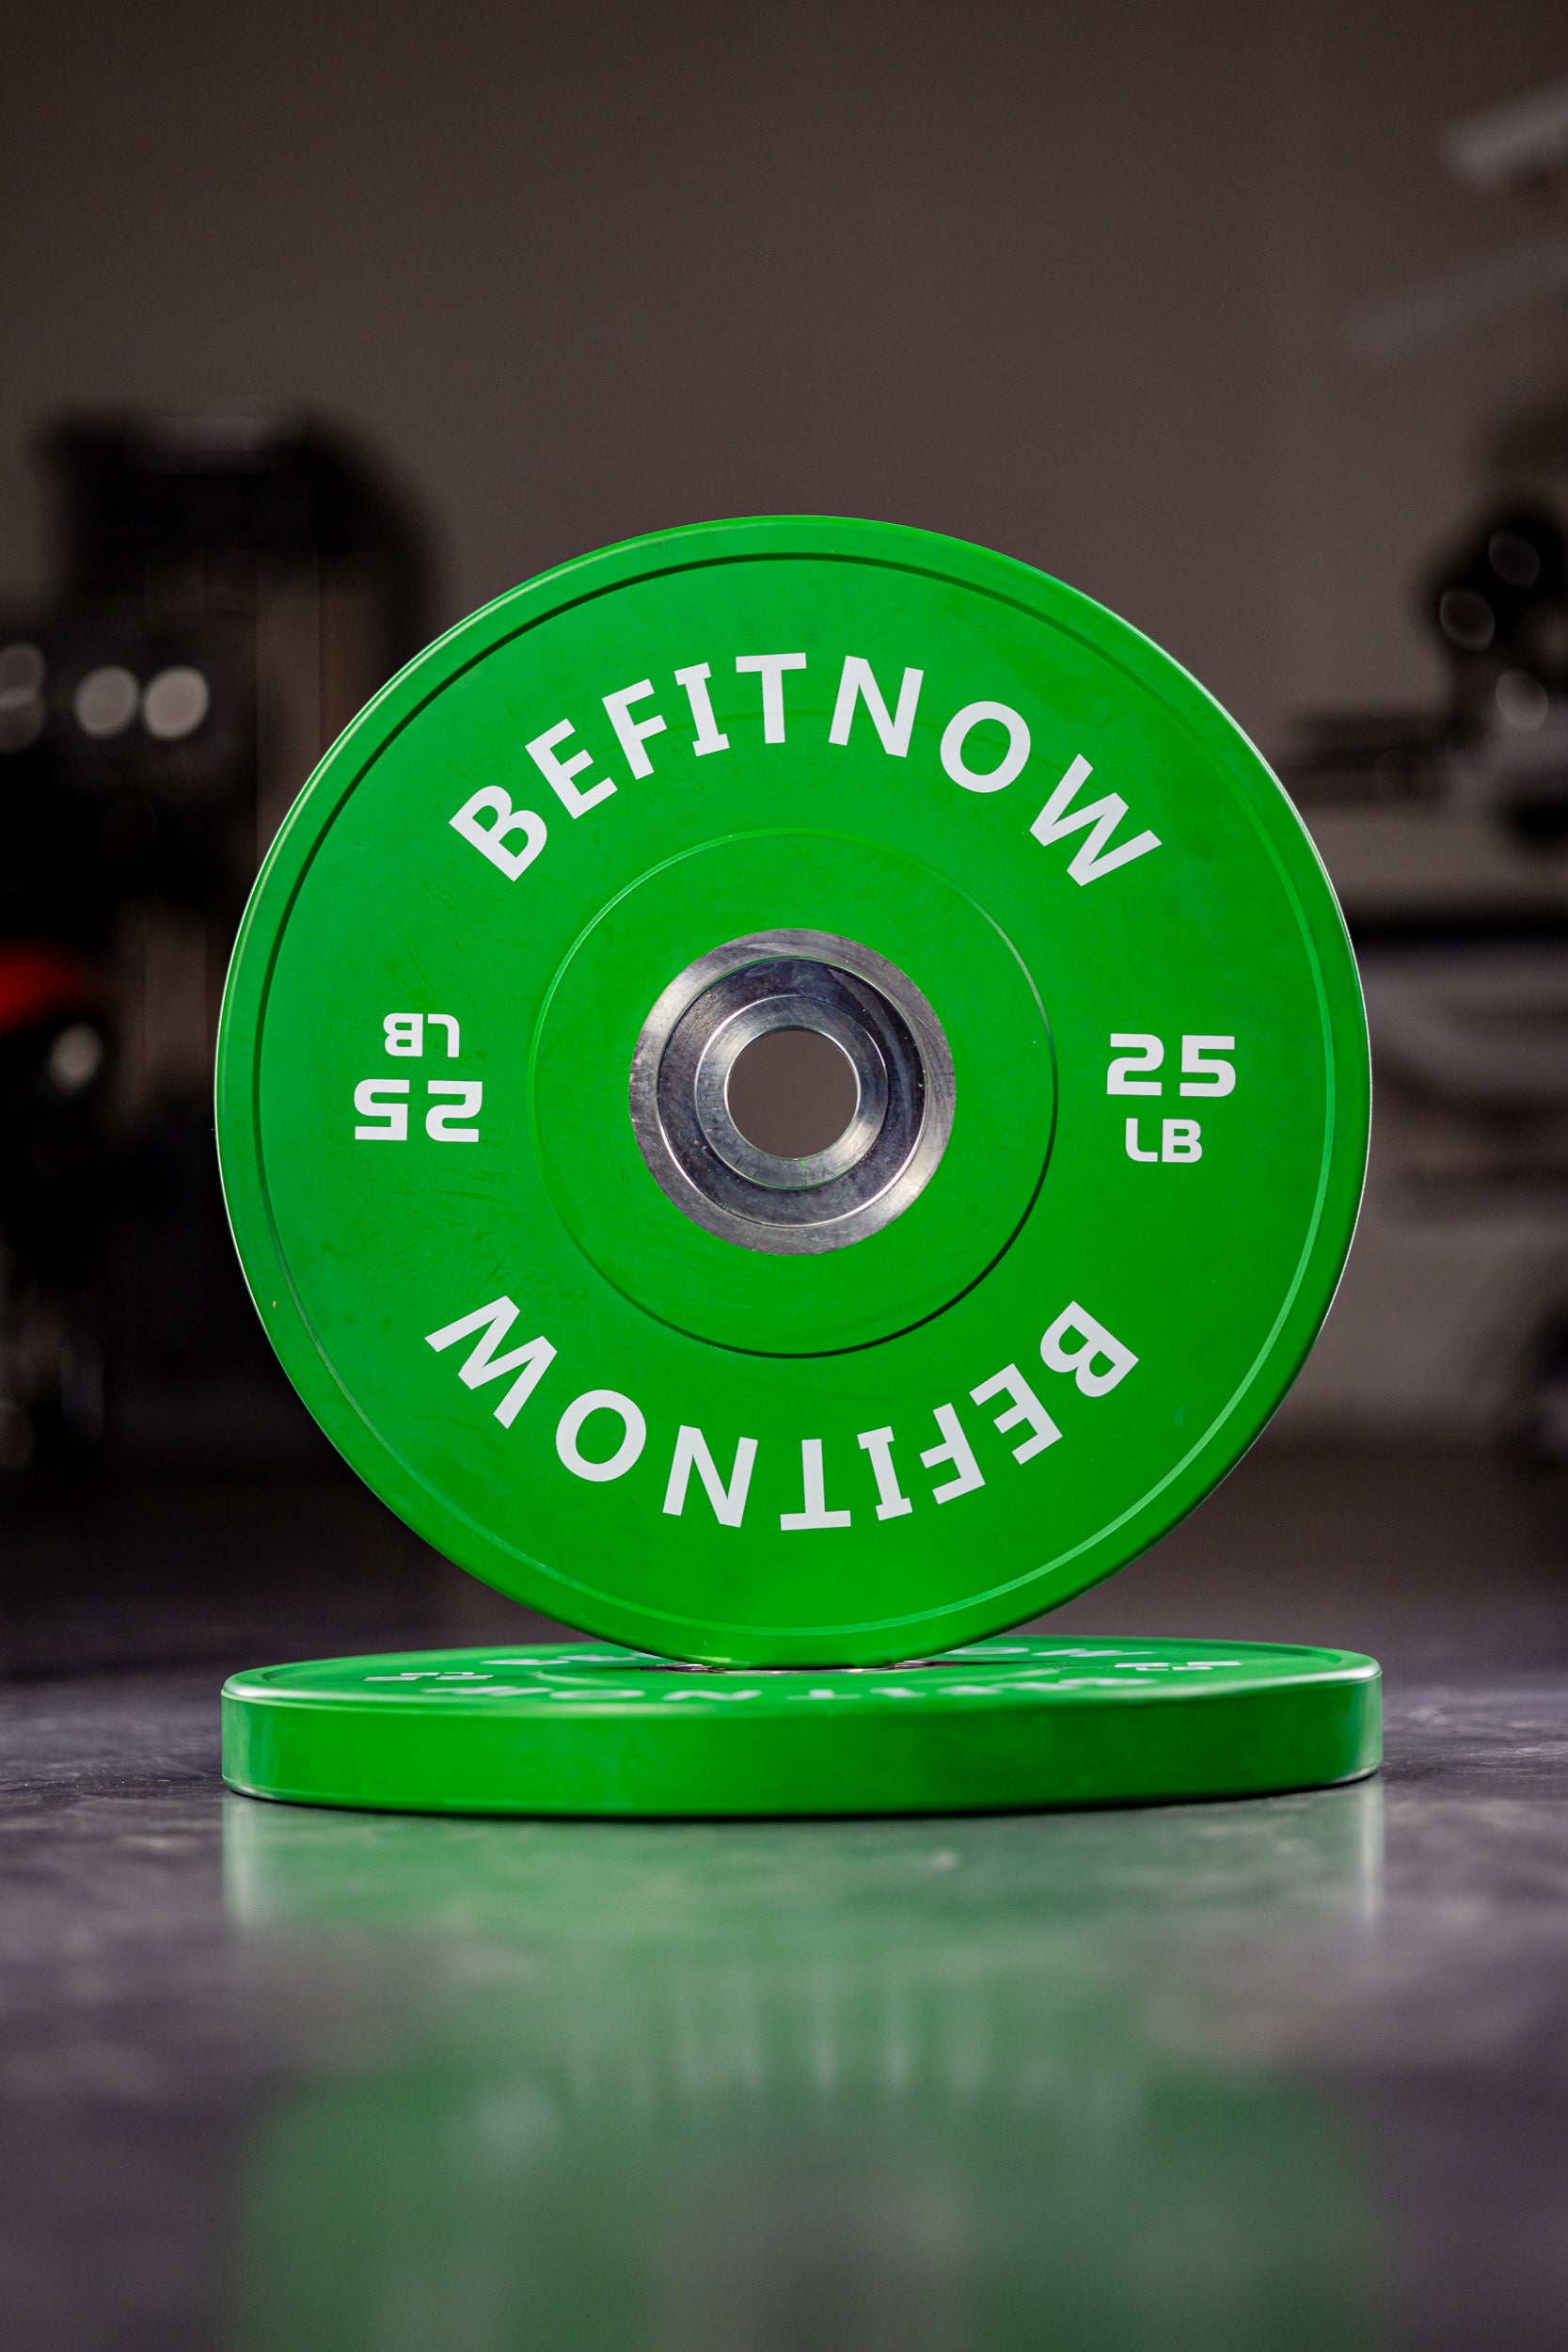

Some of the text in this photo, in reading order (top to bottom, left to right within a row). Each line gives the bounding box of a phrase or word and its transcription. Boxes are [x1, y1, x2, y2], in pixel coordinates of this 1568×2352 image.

[448, 652, 1163, 887] BEFITNOW
[383, 1012, 460, 1058] LB
[1106, 1033, 1236, 1098] 25
[354, 1078, 483, 1143] 25
[1125, 1118, 1203, 1164] LB
[424, 1295, 1139, 1531] BEFITNOW
